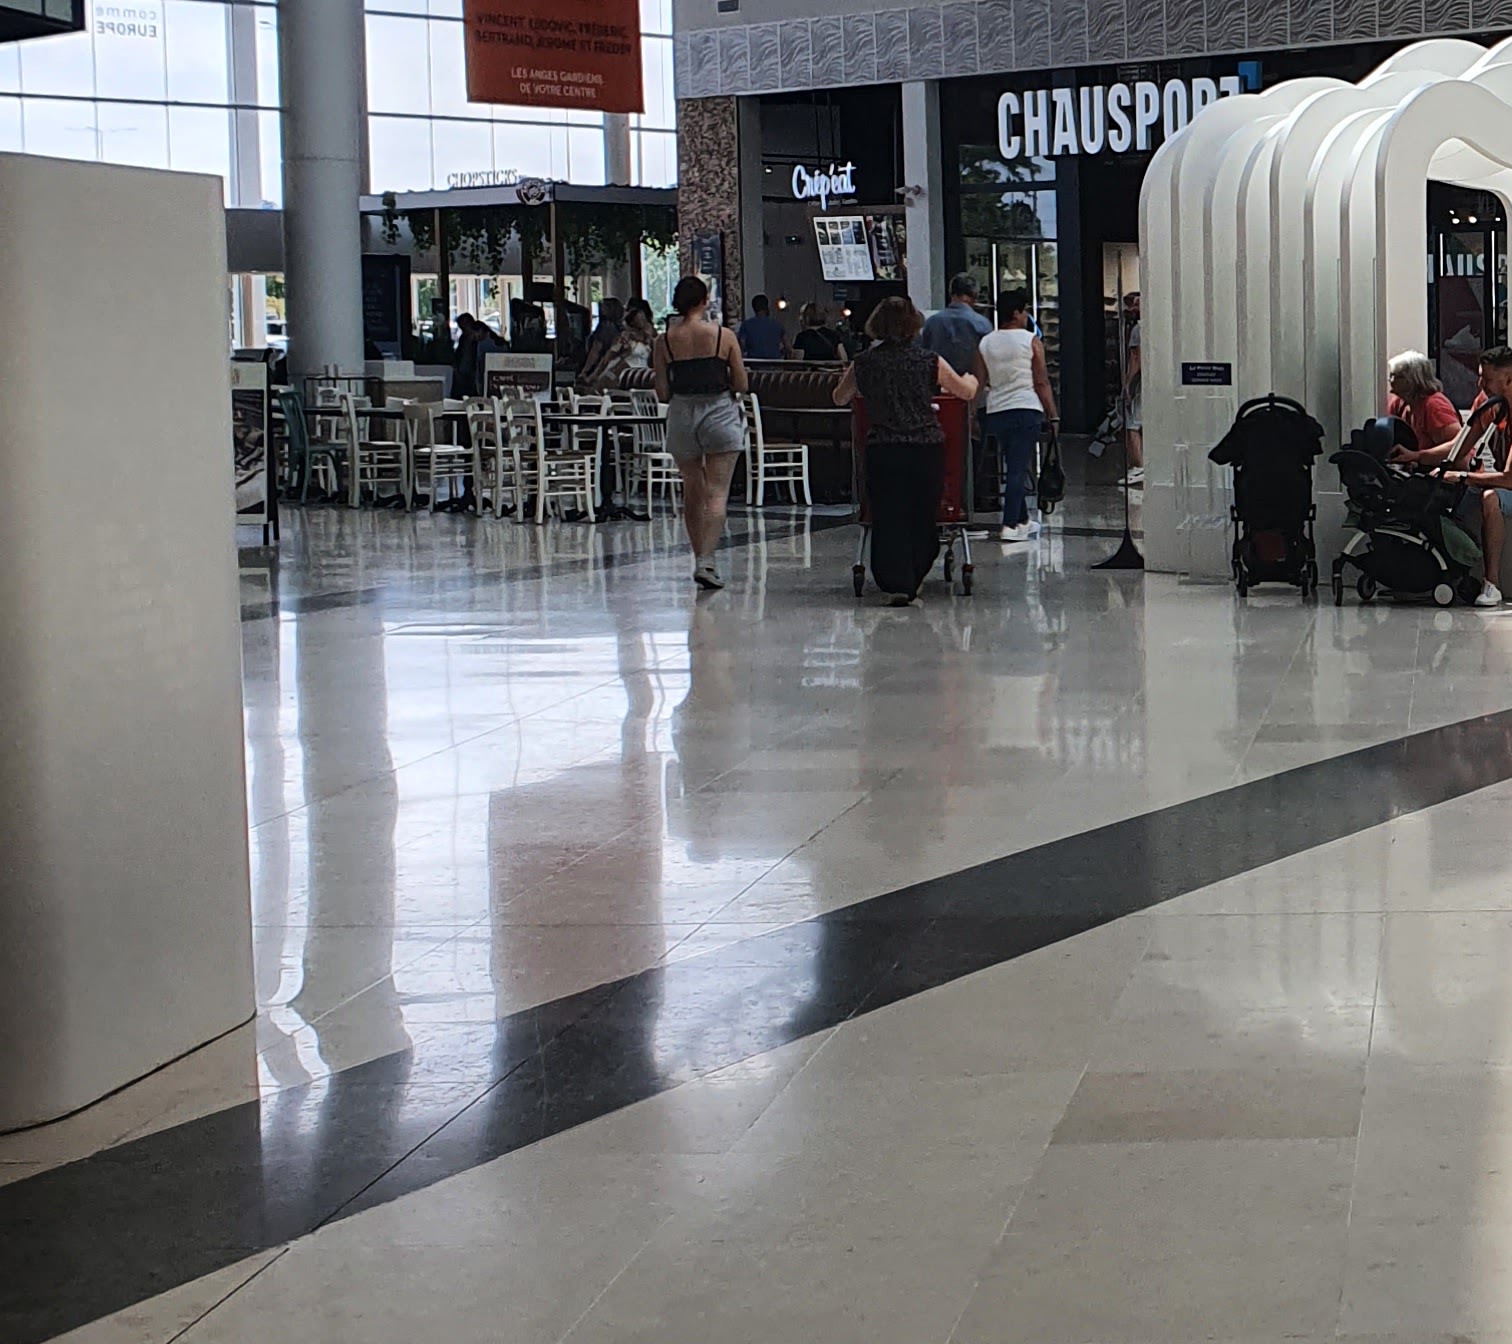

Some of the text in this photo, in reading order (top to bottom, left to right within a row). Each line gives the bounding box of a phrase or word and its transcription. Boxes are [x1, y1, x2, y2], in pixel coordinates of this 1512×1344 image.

[510, 66, 528, 79] LES
[529, 69, 558, 82] ANGES
[519, 82, 597, 98] DE VOTRE CENTRE
[447, 168, 518, 188] CHOPSTICKS
